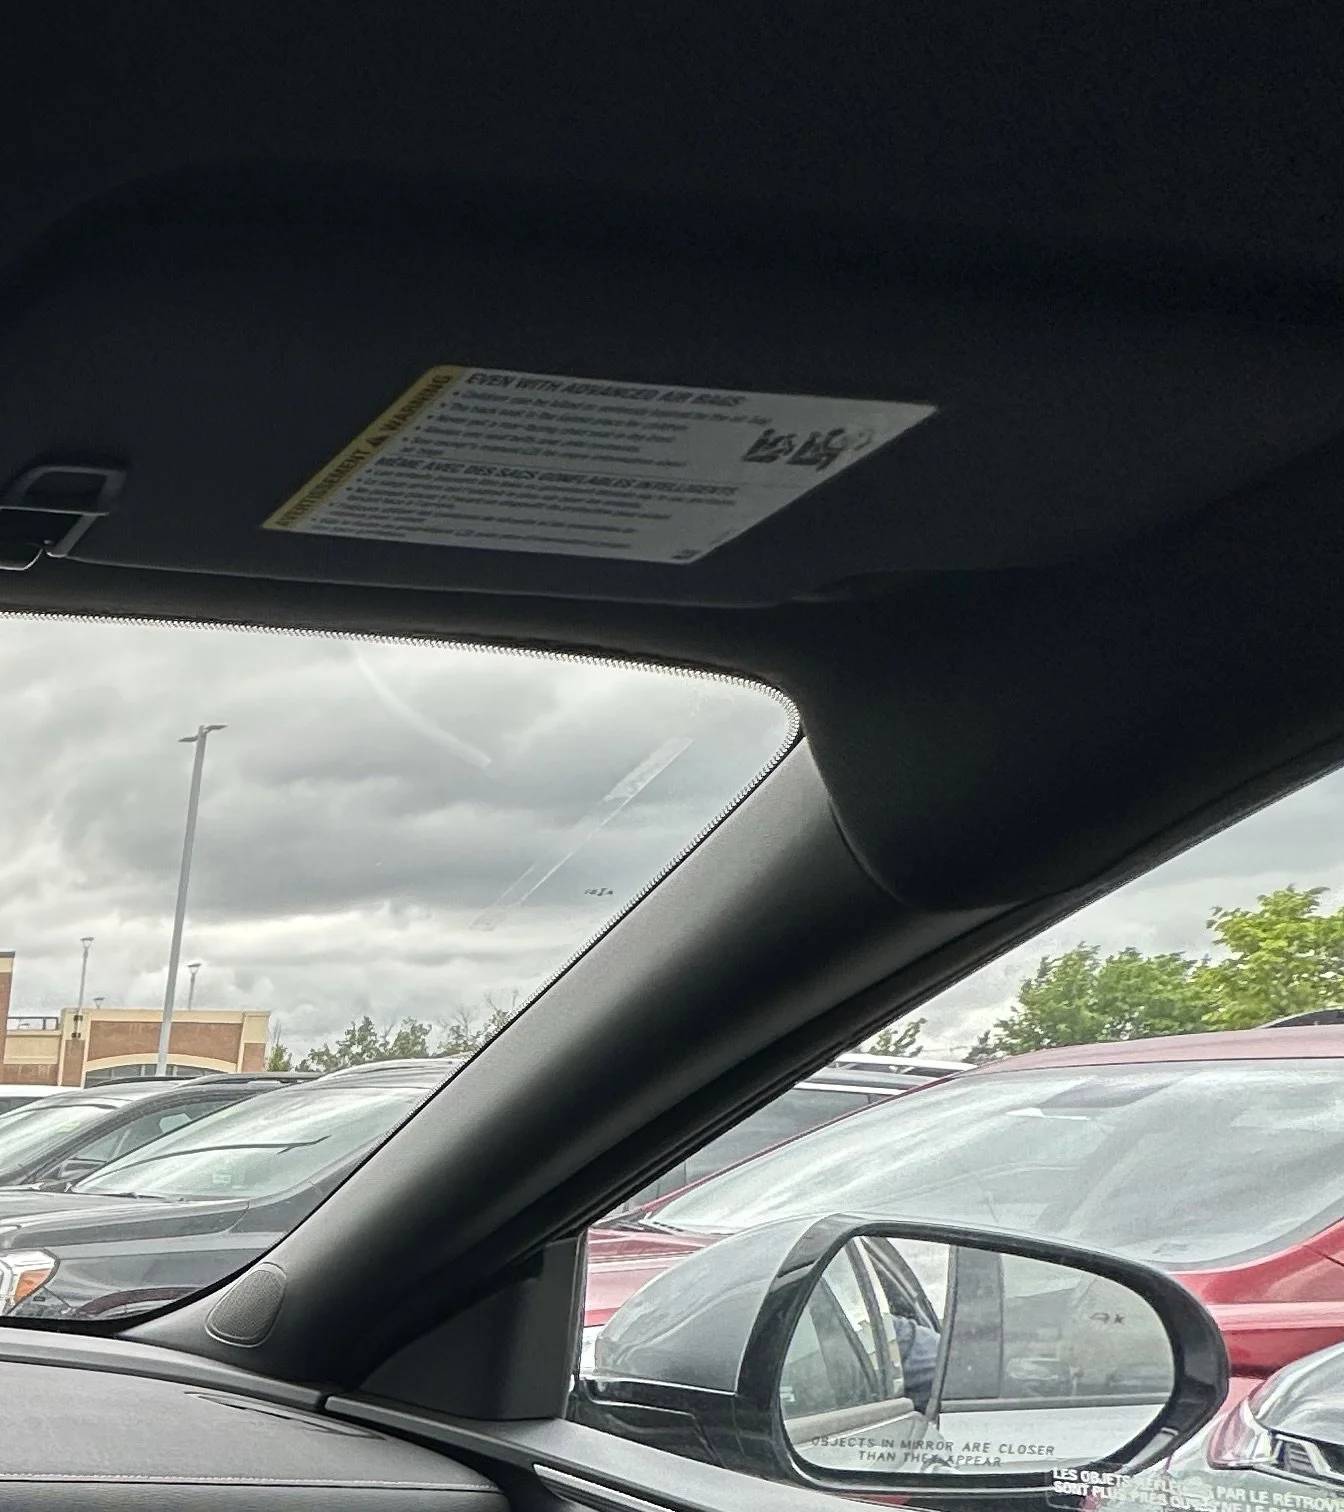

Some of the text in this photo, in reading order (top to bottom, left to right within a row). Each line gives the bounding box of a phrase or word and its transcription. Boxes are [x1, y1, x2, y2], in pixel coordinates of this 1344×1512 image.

[468, 372, 516, 387] EVEN
[516, 377, 561, 391] WITH
[561, 382, 660, 400] ADVANCED
[811, 1436, 1055, 1457] OBJECTS IN MIRROR ARE CLOSER
[858, 1450, 897, 1462] THAN
[946, 1454, 1003, 1467] APPEAR
[1052, 1468, 1079, 1482] LES
[1080, 1470, 1132, 1487] OBJETS
[1216, 1485, 1247, 1502] PAR
[1250, 1489, 1270, 1505] LE
[1052, 1480, 1090, 1497] SONT
